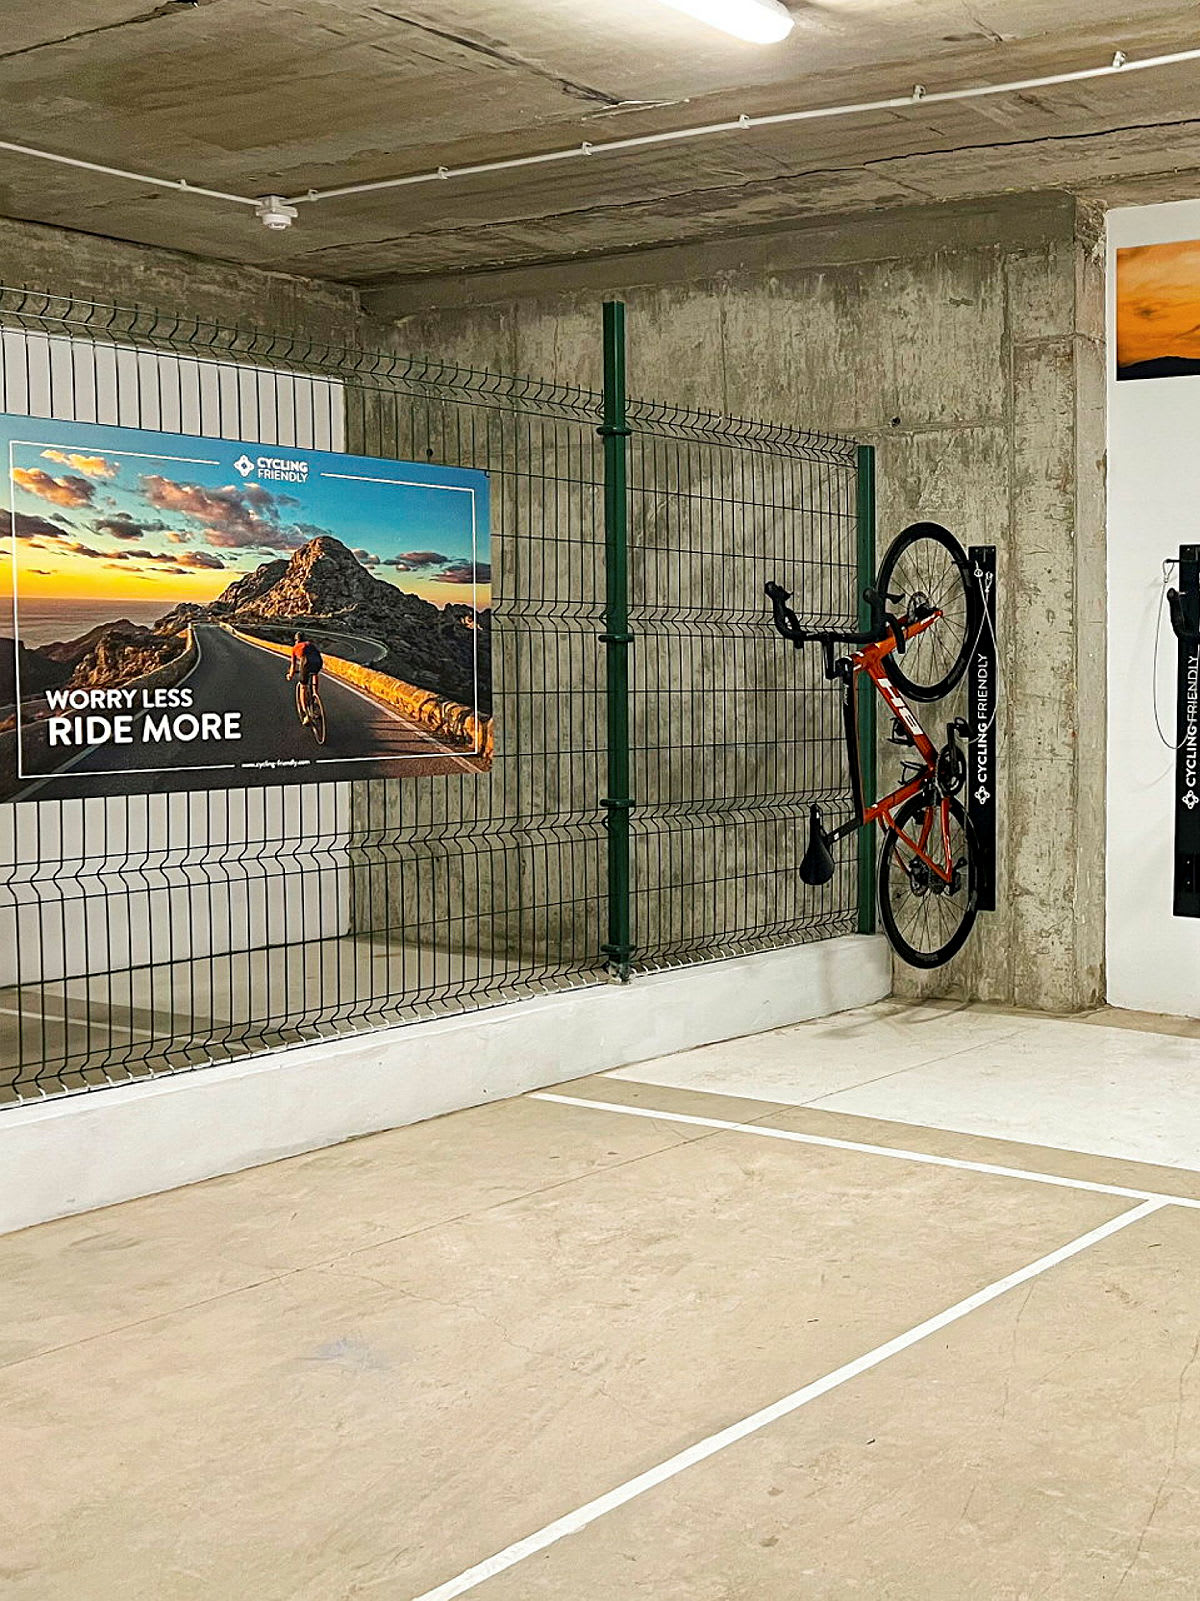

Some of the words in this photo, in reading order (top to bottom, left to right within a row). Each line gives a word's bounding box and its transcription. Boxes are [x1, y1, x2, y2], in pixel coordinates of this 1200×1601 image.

[257, 457, 309, 473] CYCLING
[257, 469, 309, 483] FRIENDLY
[45, 689, 139, 711] WORRY
[142, 688, 193, 709] LESS
[977, 653, 989, 720] FRIENDLY
[1187, 655, 1199, 723] FRIENDLY
[48, 714, 134, 746] RIDE
[142, 712, 242, 743] MORE
[978, 722, 989, 783] CYCLING
[1186, 725, 1198, 787] CYCLING
